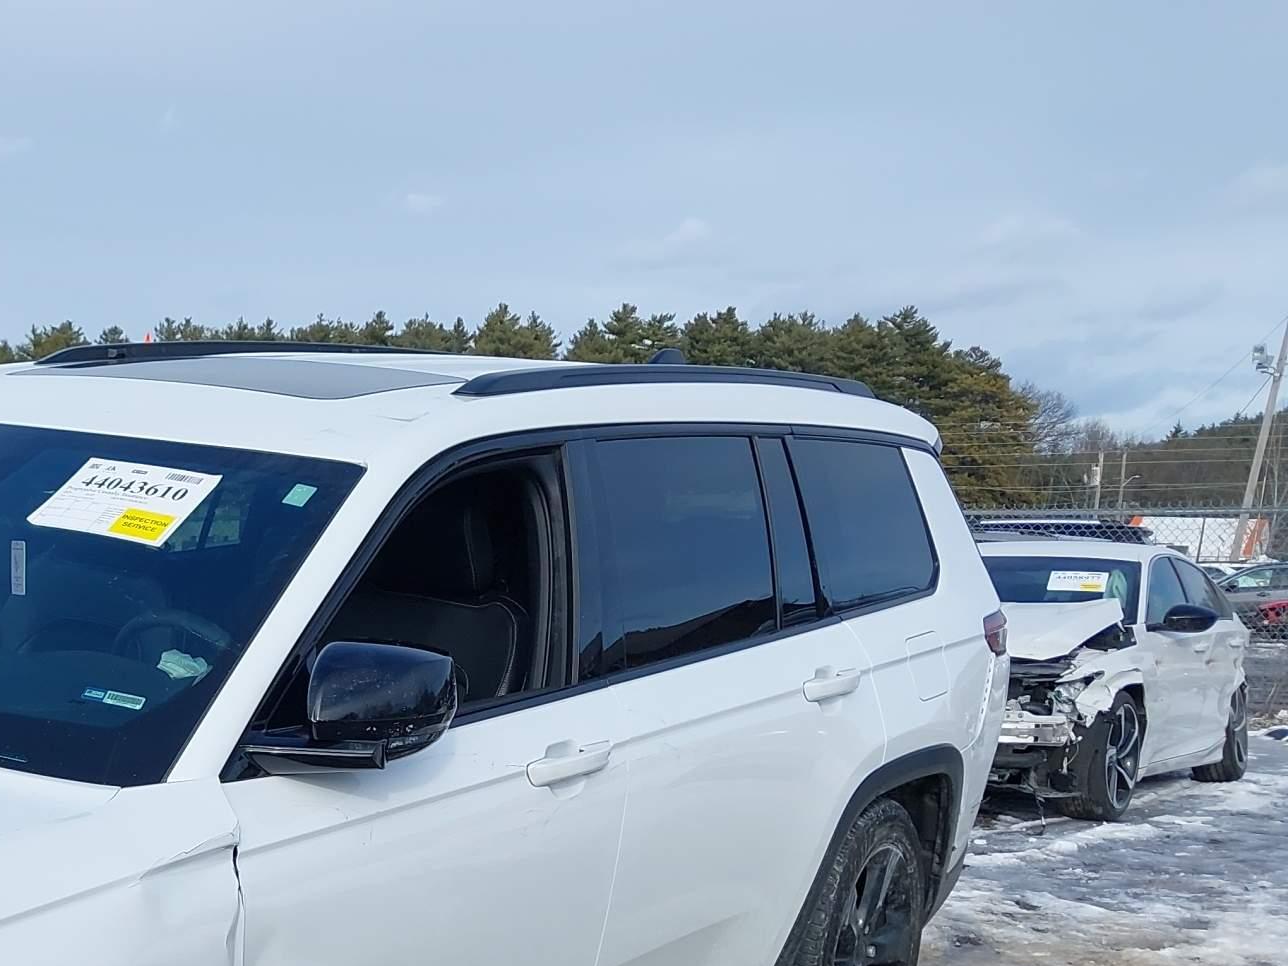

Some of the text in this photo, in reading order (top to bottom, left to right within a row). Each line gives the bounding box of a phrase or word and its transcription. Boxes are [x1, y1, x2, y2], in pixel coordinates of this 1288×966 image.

[82, 475, 189, 501] 44043610
[122, 514, 169, 527] INSPECTION
[122, 521, 158, 532] SERVICE
